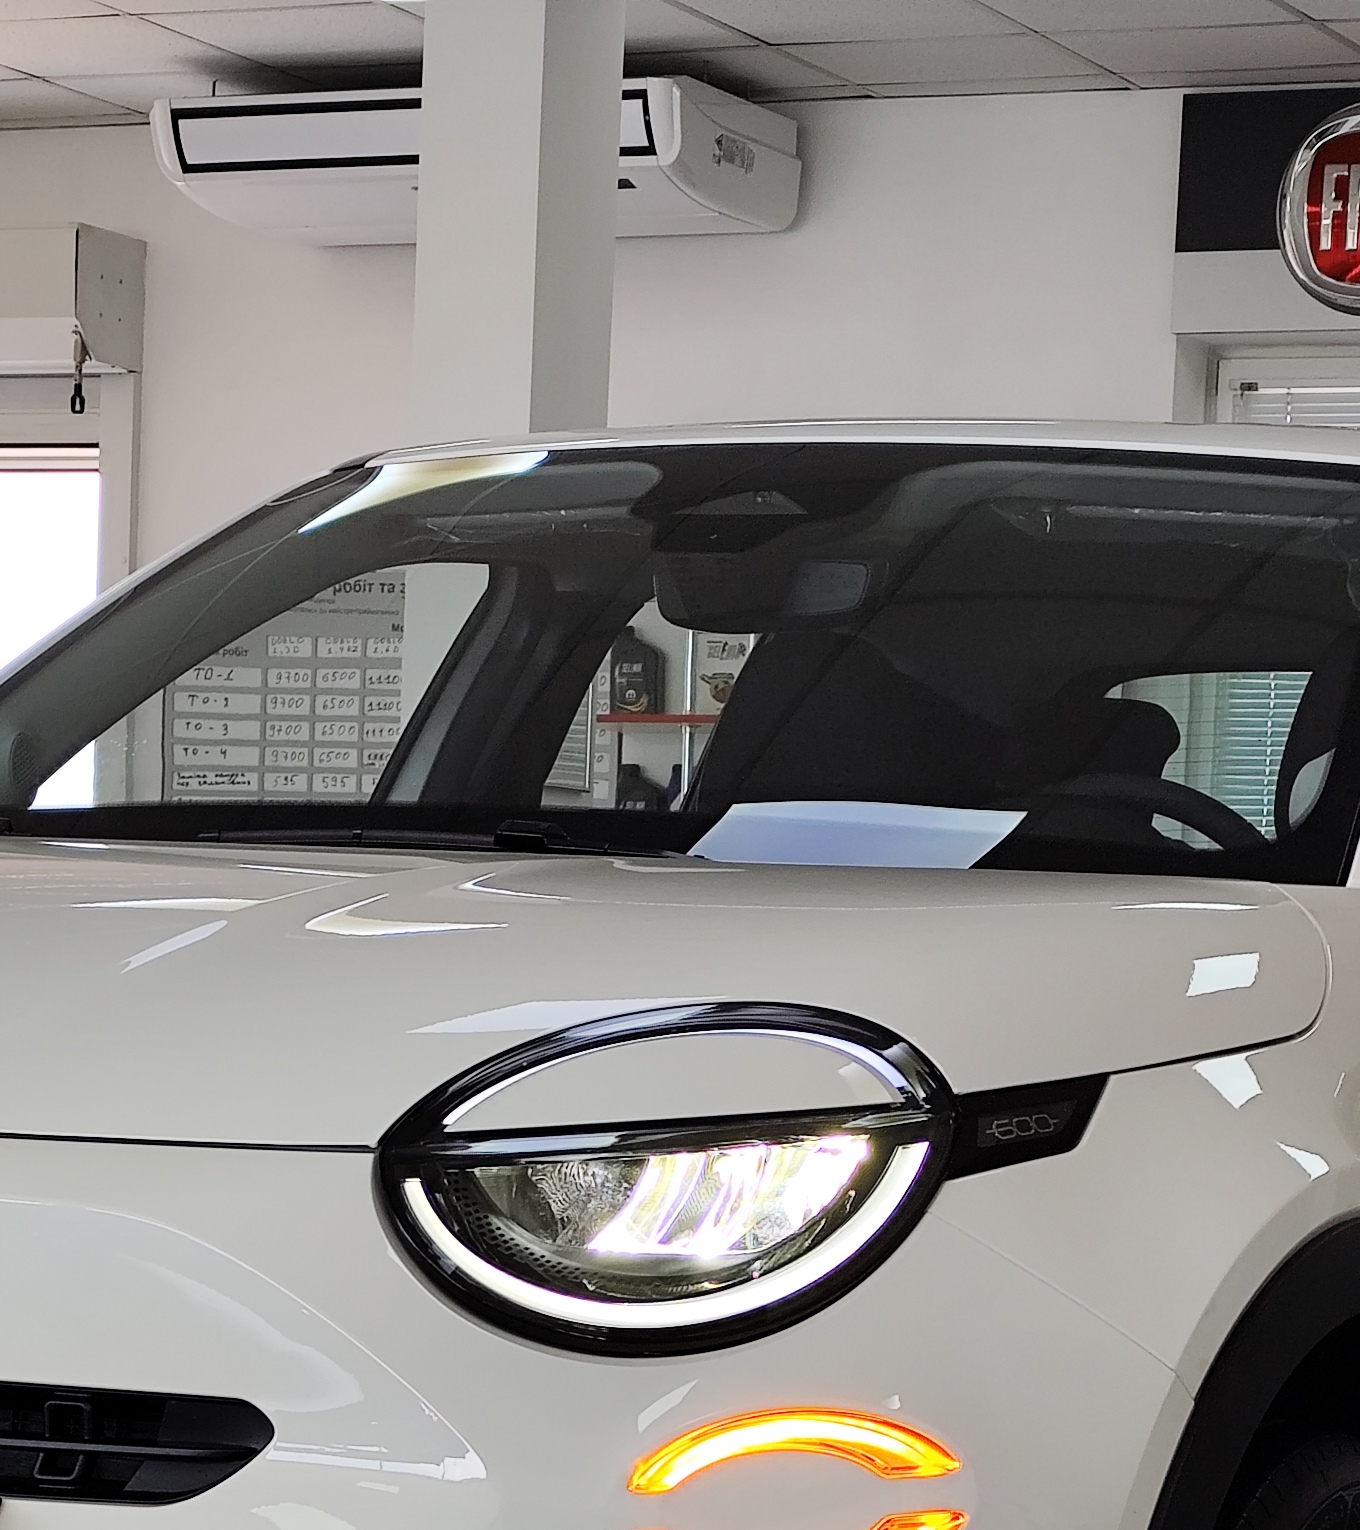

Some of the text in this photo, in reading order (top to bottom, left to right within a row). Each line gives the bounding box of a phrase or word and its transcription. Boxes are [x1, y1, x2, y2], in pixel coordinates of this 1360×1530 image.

[380, 581, 396, 594] та
[275, 671, 309, 685] 9700
[322, 671, 357, 683] 6500
[270, 696, 305, 710] 9700
[322, 697, 355, 711] 6500
[269, 724, 302, 737] 9700
[322, 723, 356, 737] 6500
[271, 749, 306, 763] 9700
[319, 751, 350, 764] 6500
[322, 776, 350, 790] 595
